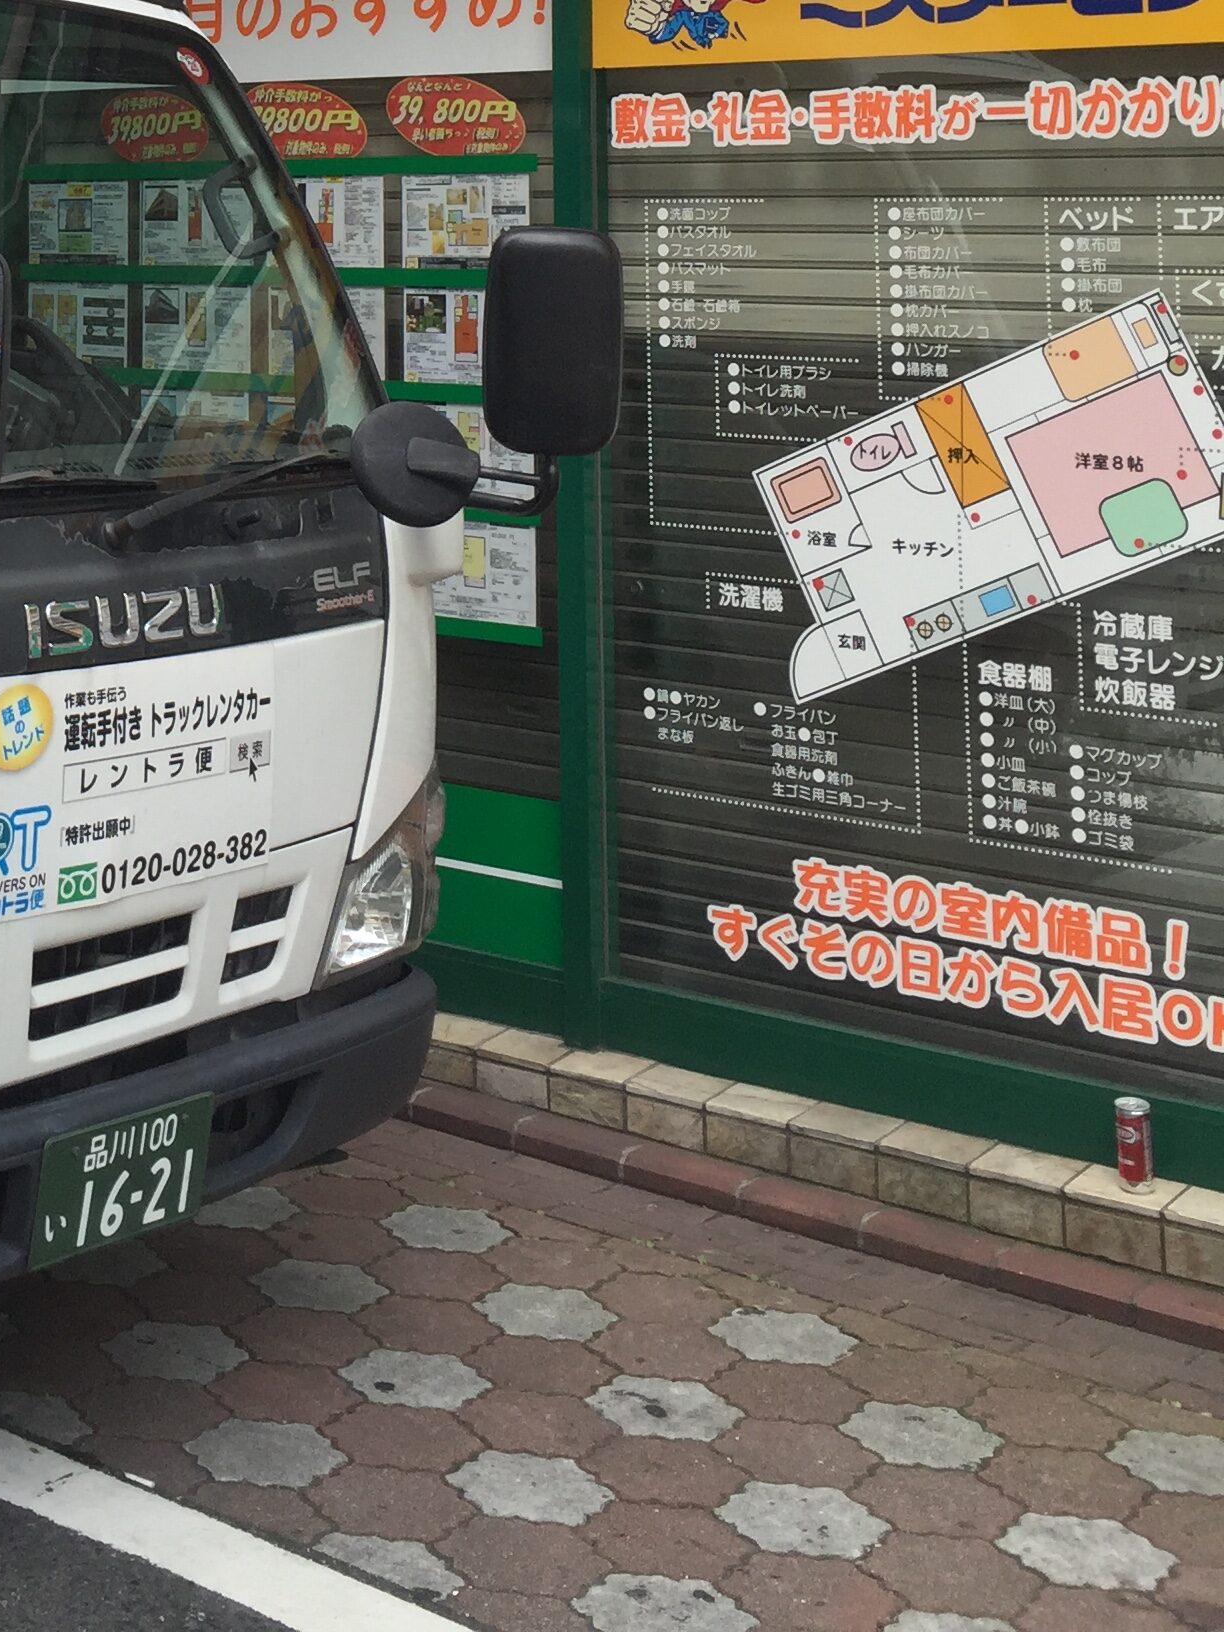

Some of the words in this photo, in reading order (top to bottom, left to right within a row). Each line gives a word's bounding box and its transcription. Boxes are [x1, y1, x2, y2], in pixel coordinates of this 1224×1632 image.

[612, 76, 1224, 149] 敷金・礼金・手数料が一切かかり
[669, 206, 732, 222] 洗面コップ
[902, 206, 986, 222] 座布団カバー
[1058, 205, 1135, 232] ベッド
[669, 225, 732, 240] バスタオル
[903, 225, 945, 241] シーツ
[670, 243, 758, 258] フェイスタオル
[904, 245, 973, 261] 布団カバー
[670, 261, 732, 276] バスマット
[1076, 257, 1107, 273] 毛布
[904, 284, 989, 300] 掛布団カバー
[1077, 278, 1123, 294] 掛布団
[905, 303, 960, 319] 枕カバー
[1077, 297, 1093, 313] 枕
[671, 315, 722, 331] スポンジ
[905, 322, 990, 340] 押入れスノコ
[671, 334, 697, 349] 洗剤
[905, 342, 962, 359] ハンガー
[741, 363, 832, 381] トイレ用ブラシ
[907, 361, 949, 378] 掃除機
[741, 383, 807, 399] トイレ洗剤
[741, 401, 859, 420] トイレットペーパー
[859, 445, 892, 461] トイレ
[947, 447, 981, 465] 押入
[1075, 452, 1145, 473] 洋室8帖
[807, 530, 838, 549] 浴室
[891, 538, 955, 558] キッチン
[313, 561, 371, 592] ELF
[718, 583, 784, 612] 洗濯機
[24, 582, 224, 660] ISUZU
[1092, 609, 1175, 643] 冷蔵庫
[837, 633, 867, 652] 玄関
[1093, 642, 1224, 681] 電子レンジ
[977, 659, 1053, 693] 食器棚
[64, 686, 127, 709] 作業も手伝う
[683, 693, 721, 710] ヤカン
[1094, 674, 1177, 711] 炊飯器
[64, 705, 142, 752] 運転手付き
[151, 687, 272, 738] トラックレンタカー
[657, 707, 745, 733] フライパン返し
[770, 703, 837, 726] フライパン
[14, 719, 26, 735] の
[657, 727, 695, 745] まな板
[771, 724, 798, 741] お玉
[812, 729, 839, 746] 包丁
[771, 742, 838, 767] 食器用洗剤
[996, 754, 1027, 773] 小皿
[1085, 745, 1163, 770] マグカップ
[79, 745, 214, 795] レントラ便
[771, 762, 812, 782] ふきん
[1087, 767, 1132, 787] コップ
[771, 781, 908, 814] 生ゴミ用三角コーナー
[1087, 809, 1133, 830] 栓抜き
[1088, 830, 1134, 852] ゴミ袋
[101, 828, 268, 894] 0120-028-382
[29, 872, 46, 889] ON
[83, 1125, 137, 1173] 品川
[139, 1113, 178, 1156] 100
[44, 1215, 68, 1243] い
[76, 1147, 194, 1248] 16-21
